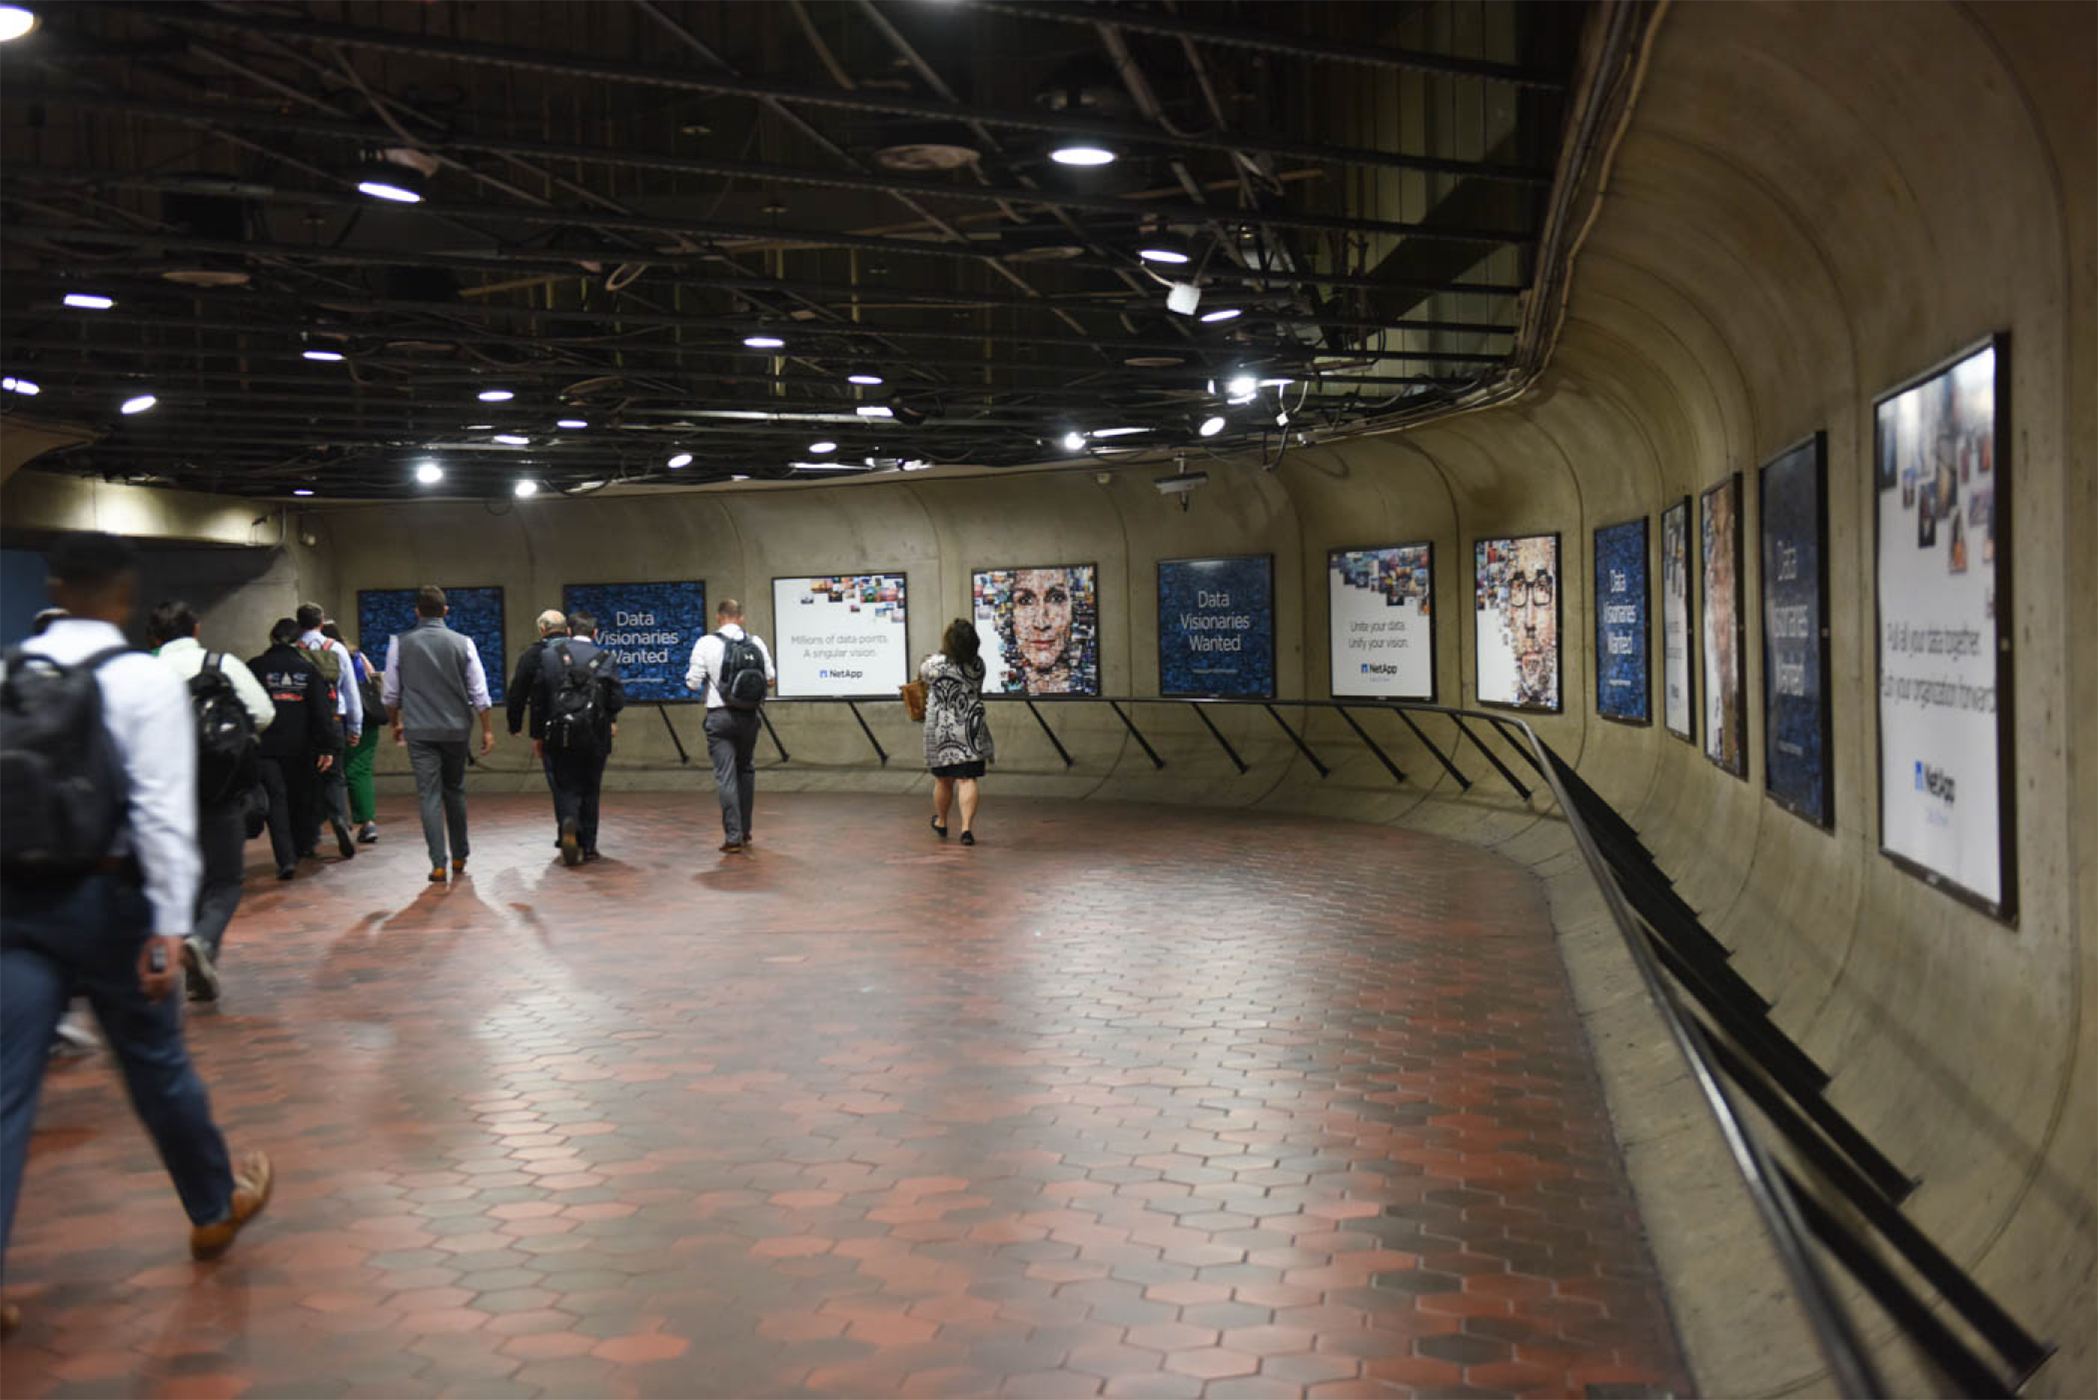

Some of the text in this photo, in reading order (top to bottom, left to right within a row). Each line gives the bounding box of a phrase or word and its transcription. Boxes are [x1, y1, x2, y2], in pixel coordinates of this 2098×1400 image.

[1609, 569, 1626, 593] Data
[1198, 590, 1230, 608] Data
[616, 611, 655, 626] Data
[1179, 611, 1251, 630] Visionaries
[1369, 622, 1386, 634] your
[595, 629, 680, 646] Visionaries
[790, 635, 824, 645] Millions
[825, 634, 835, 644] of
[837, 635, 858, 645] data
[1189, 633, 1242, 652] Wanted
[1348, 637, 1367, 651] Unify
[1367, 638, 1385, 651] your
[802, 649, 811, 658] A
[812, 649, 848, 660] singular
[829, 669, 864, 679] NetApp
[1369, 663, 1398, 675] NetApp
